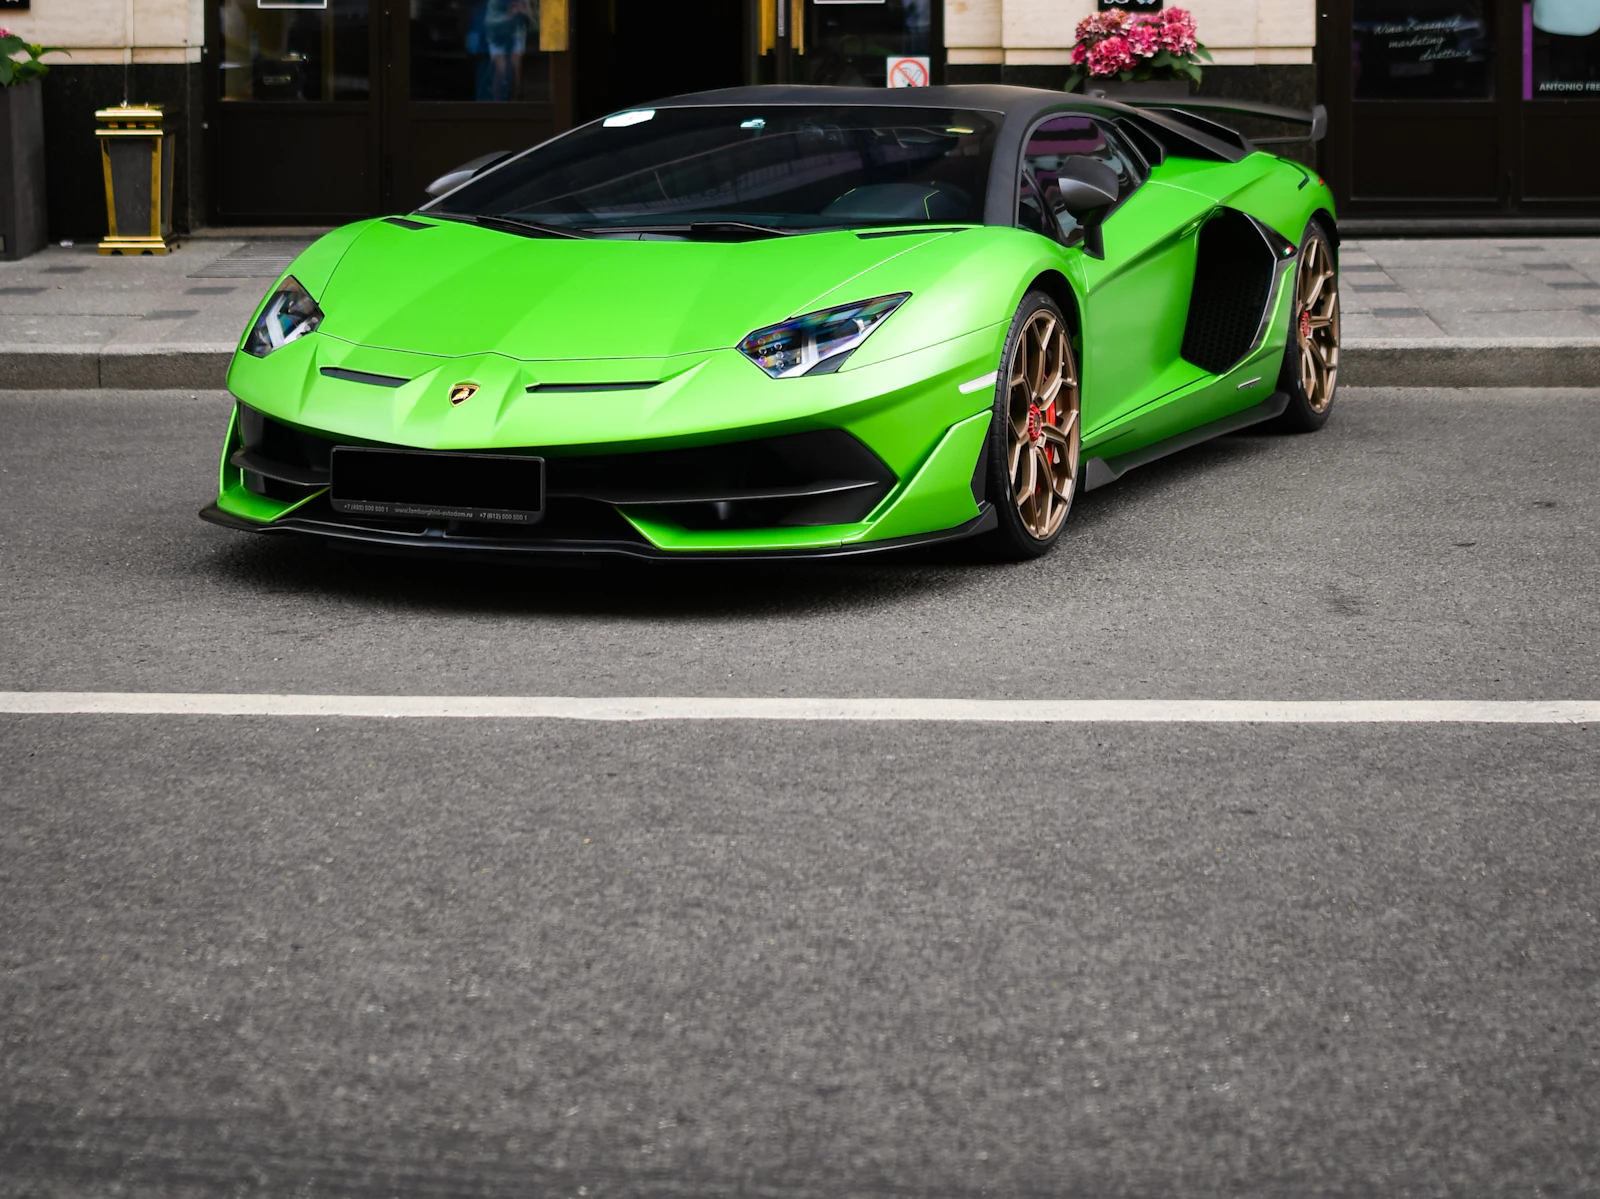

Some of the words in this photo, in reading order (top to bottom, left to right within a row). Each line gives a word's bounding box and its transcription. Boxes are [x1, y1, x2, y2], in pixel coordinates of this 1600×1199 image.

[1388, 34, 1445, 51] marketing
[1539, 82, 1584, 92] ANTONIO
[394, 506, 474, 518] www.lamborghini-avtodom.ru
